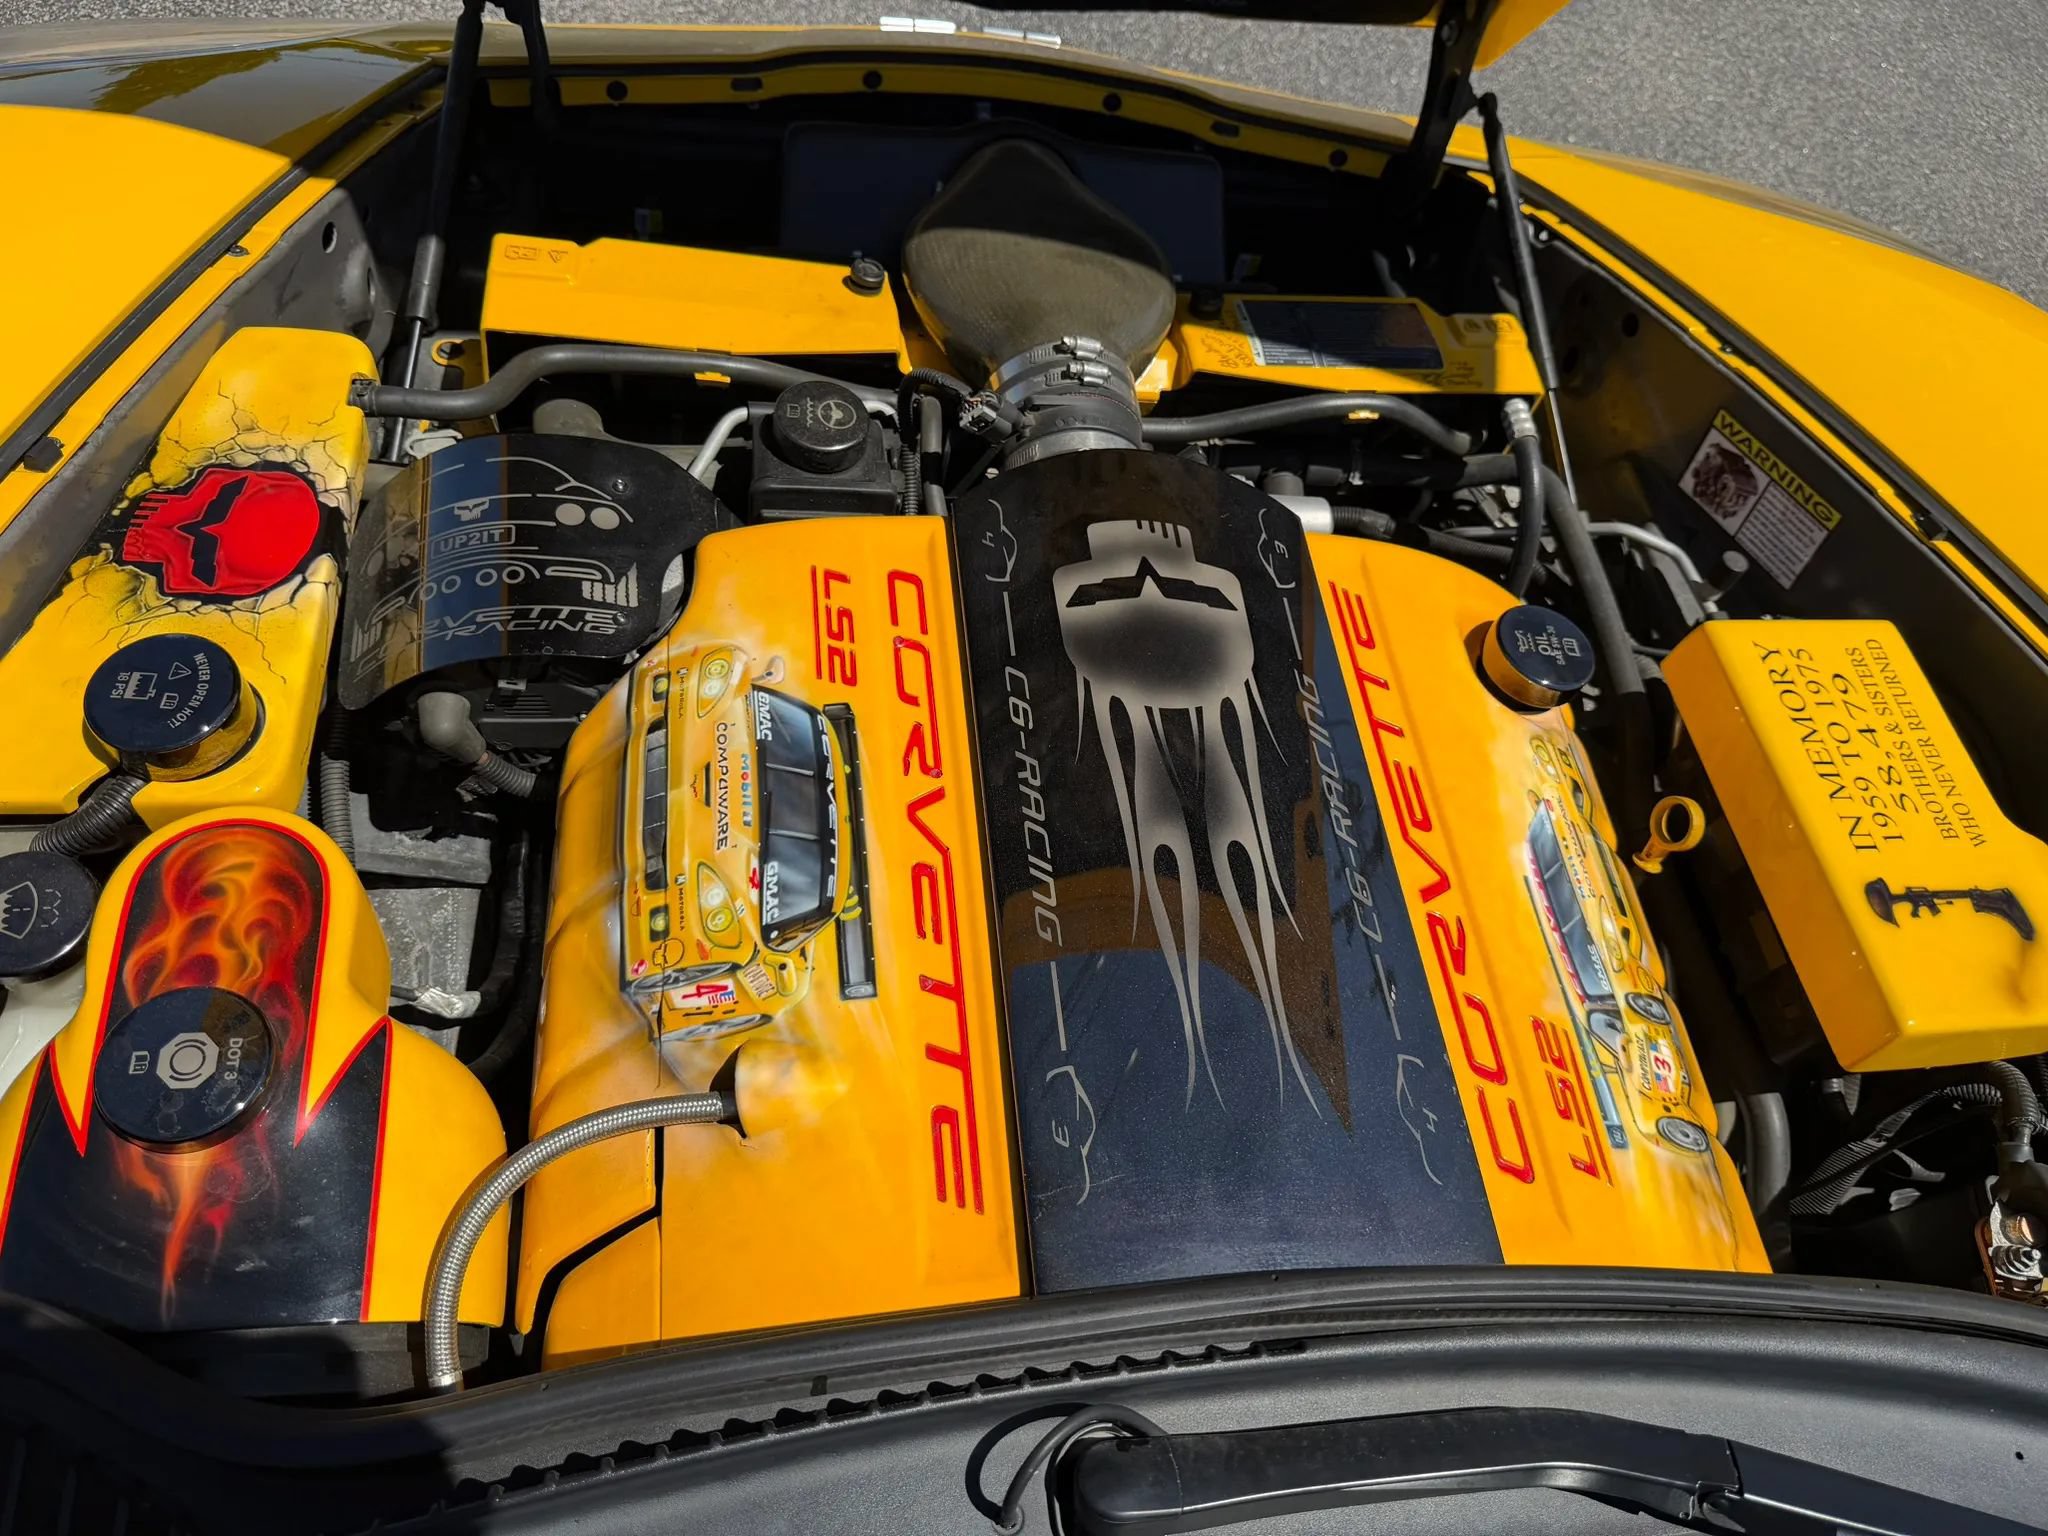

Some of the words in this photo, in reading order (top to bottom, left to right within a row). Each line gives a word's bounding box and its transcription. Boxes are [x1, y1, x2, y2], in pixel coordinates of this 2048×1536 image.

[1720, 414, 1834, 524] WARNING
[440, 530, 505, 552] UP2IT
[981, 531, 995, 548] 4
[1274, 539, 1289, 559] 3
[424, 619, 619, 643] RACING
[823, 568, 858, 687] LS2
[1535, 632, 1551, 656] OIL
[117, 671, 131, 682] 18
[193, 652, 211, 681] NEVER
[1787, 648, 1836, 709] 1975
[1845, 646, 1894, 717] SISTERS
[1865, 638, 1926, 732] RETURNED
[110, 682, 126, 699] PSI
[191, 683, 209, 708] OPEN
[167, 705, 194, 729] HOT!
[758, 691, 773, 741] GMAC
[1752, 640, 1855, 803] MEMORY
[1884, 722, 1903, 735] &
[1826, 721, 1863, 766] TO
[716, 722, 730, 851] COMPUWARE
[1916, 736, 1963, 799] NEVER
[816, 714, 839, 898] CORVETTE
[1004, 665, 1064, 948] C6-RACING
[1294, 668, 1383, 943] C6-RACING
[1853, 776, 1905, 844] 1959
[1892, 740, 1960, 841] BROTHERS
[1837, 813, 1880, 853] IN
[1952, 802, 1988, 848] WHO
[765, 861, 780, 923] GMAC
[887, 569, 984, 1215] CORVETTE
[1328, 580, 1535, 1184] CORVETTE
[678, 887, 686, 931] MOTOROLA
[682, 983, 729, 999] 4
[224, 1071, 238, 1080] 3
[226, 1037, 243, 1070] DOT
[1653, 1055, 1672, 1073] 3
[1529, 1015, 1600, 1179] LS2
[1052, 1119, 1069, 1148] 3
[1422, 1107, 1438, 1133] 4
